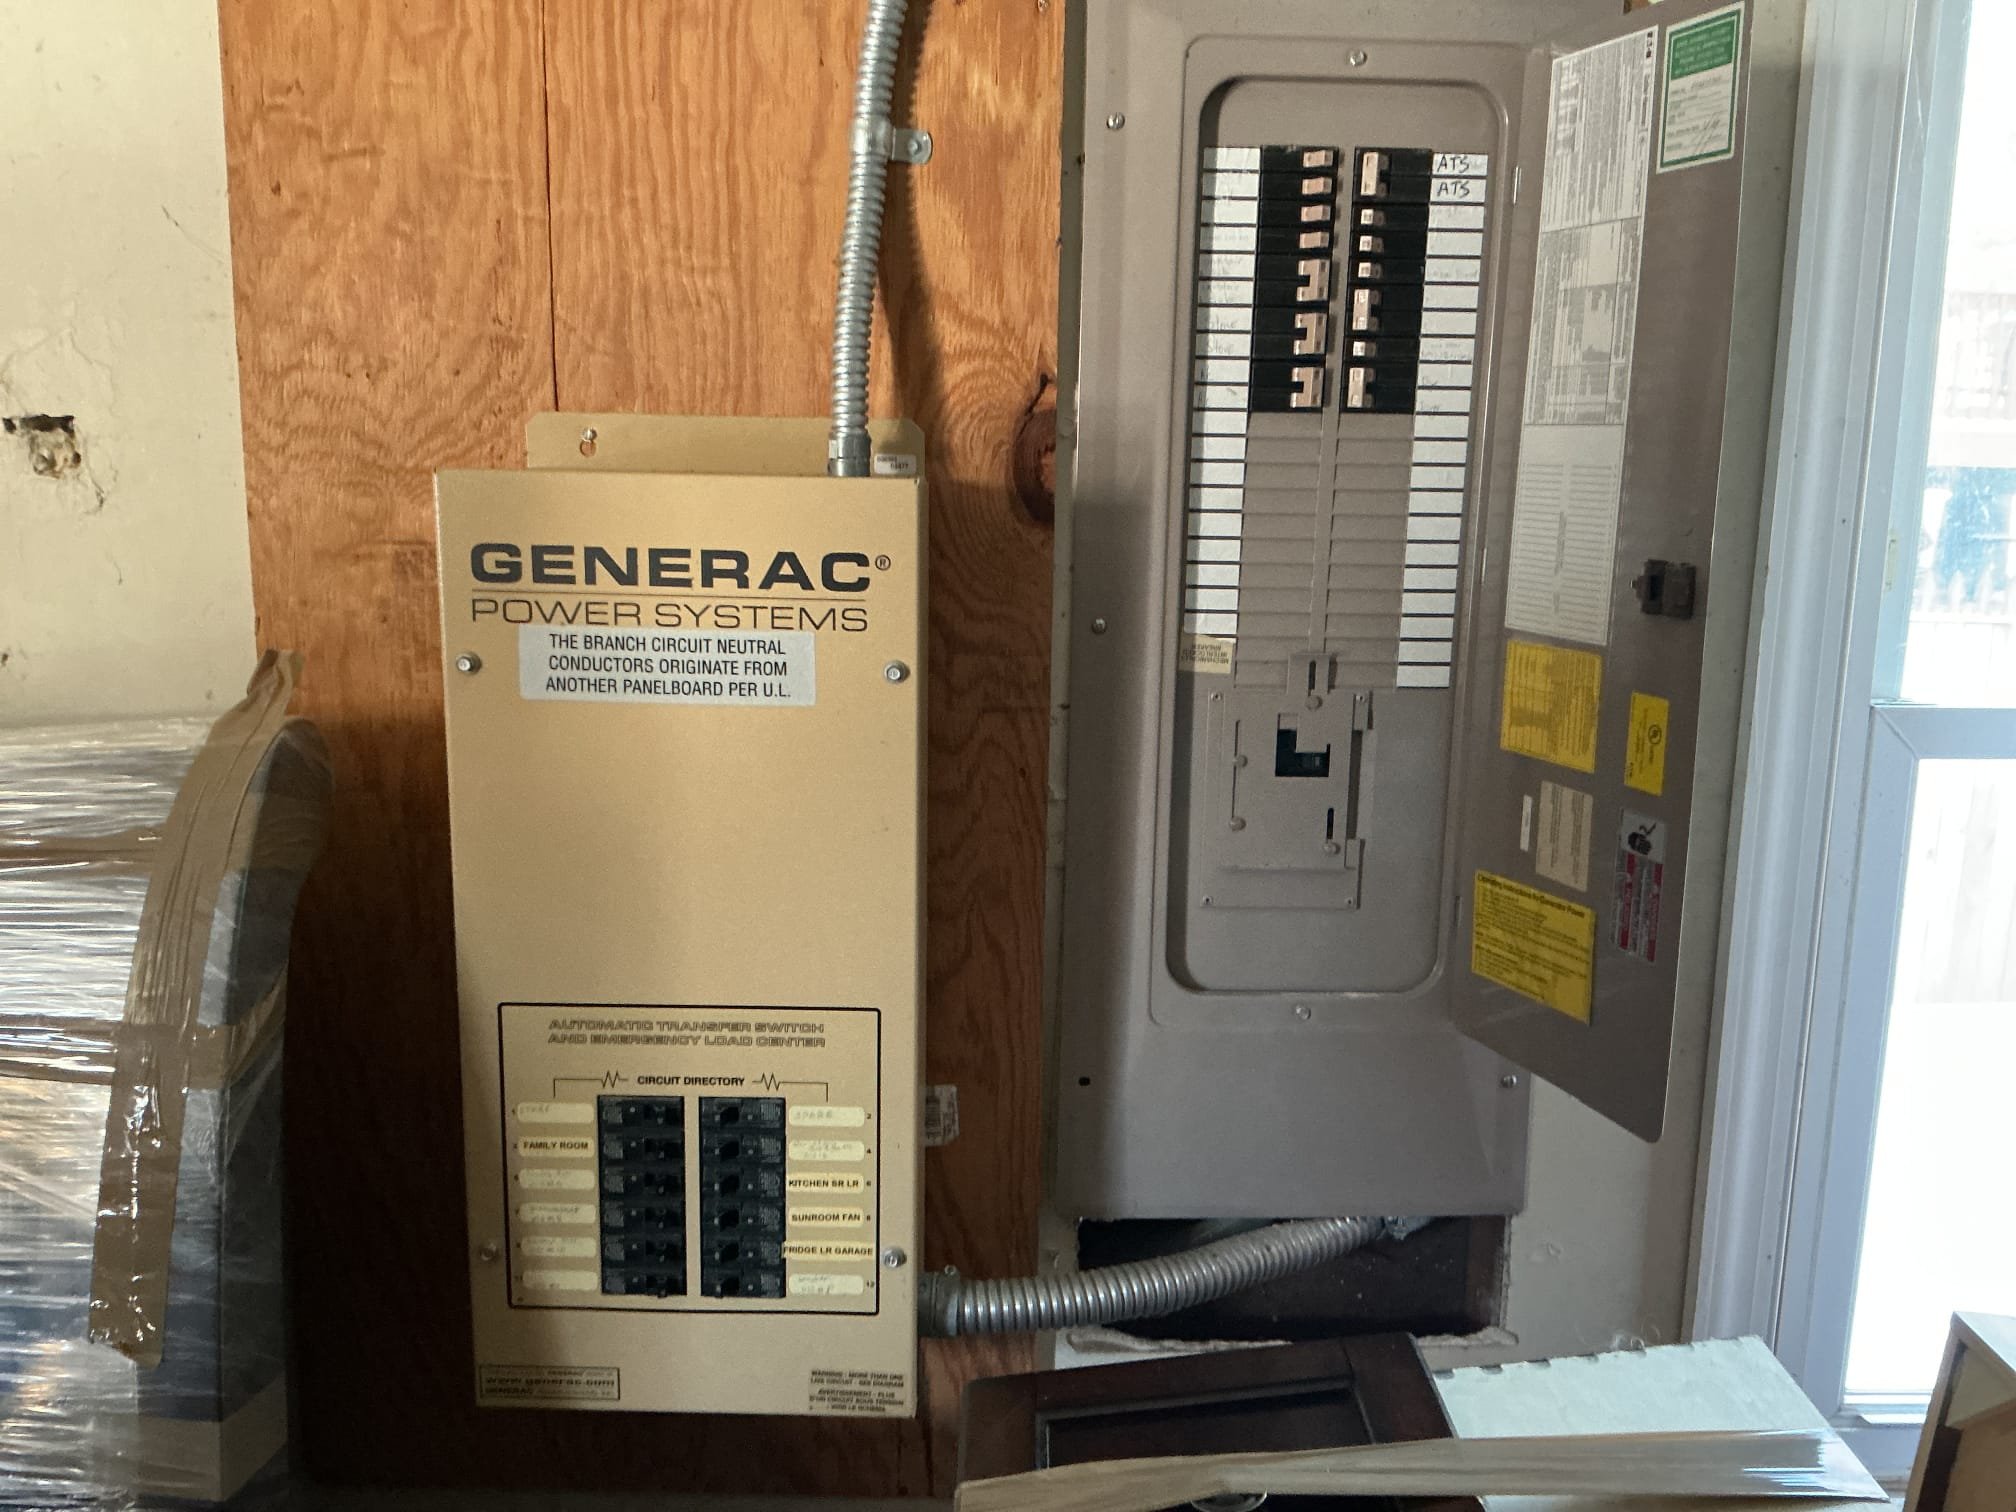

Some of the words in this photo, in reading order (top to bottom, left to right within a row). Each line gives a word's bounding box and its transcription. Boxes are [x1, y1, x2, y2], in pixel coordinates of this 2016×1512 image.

[472, 598, 642, 626] POWER
[655, 603, 868, 632] SYSTEMS
[549, 633, 579, 650] THE
[583, 635, 647, 653] BRANCH
[650, 637, 712, 654] CIRCUIT
[716, 638, 786, 655] NEUTRAL
[549, 654, 654, 674] CONDUCTORS
[659, 658, 740, 675] ORIGINATE
[744, 660, 788, 677] FROM
[546, 676, 619, 695] ANOTHER
[622, 678, 725, 697] PANELBOARD
[728, 680, 757, 697] PER
[762, 681, 792, 698] U.L.
[549, 1019, 654, 1031] AUTOMATIC
[656, 1021, 752, 1033] TRANSFER
[755, 1022, 825, 1034] SWITCH
[547, 1034, 587, 1045] AND
[590, 1034, 702, 1046] EMERGENCY
[704, 1035, 753, 1047] LOAD
[756, 1036, 826, 1048] CENTER
[637, 1076, 681, 1085] CIRCUIT
[683, 1076, 746, 1087] DIRECTORY
[523, 1141, 557, 1150] FAMILY
[560, 1141, 589, 1150] ROOM
[789, 1179, 829, 1188] KITCHEN
[847, 1180, 859, 1188] LR
[792, 1213, 840, 1222] SUNROOM
[842, 1213, 861, 1222] FAN
[783, 1246, 817, 1255] FRIDGE
[820, 1247, 832, 1255] LR
[834, 1247, 873, 1256] GARAGE
